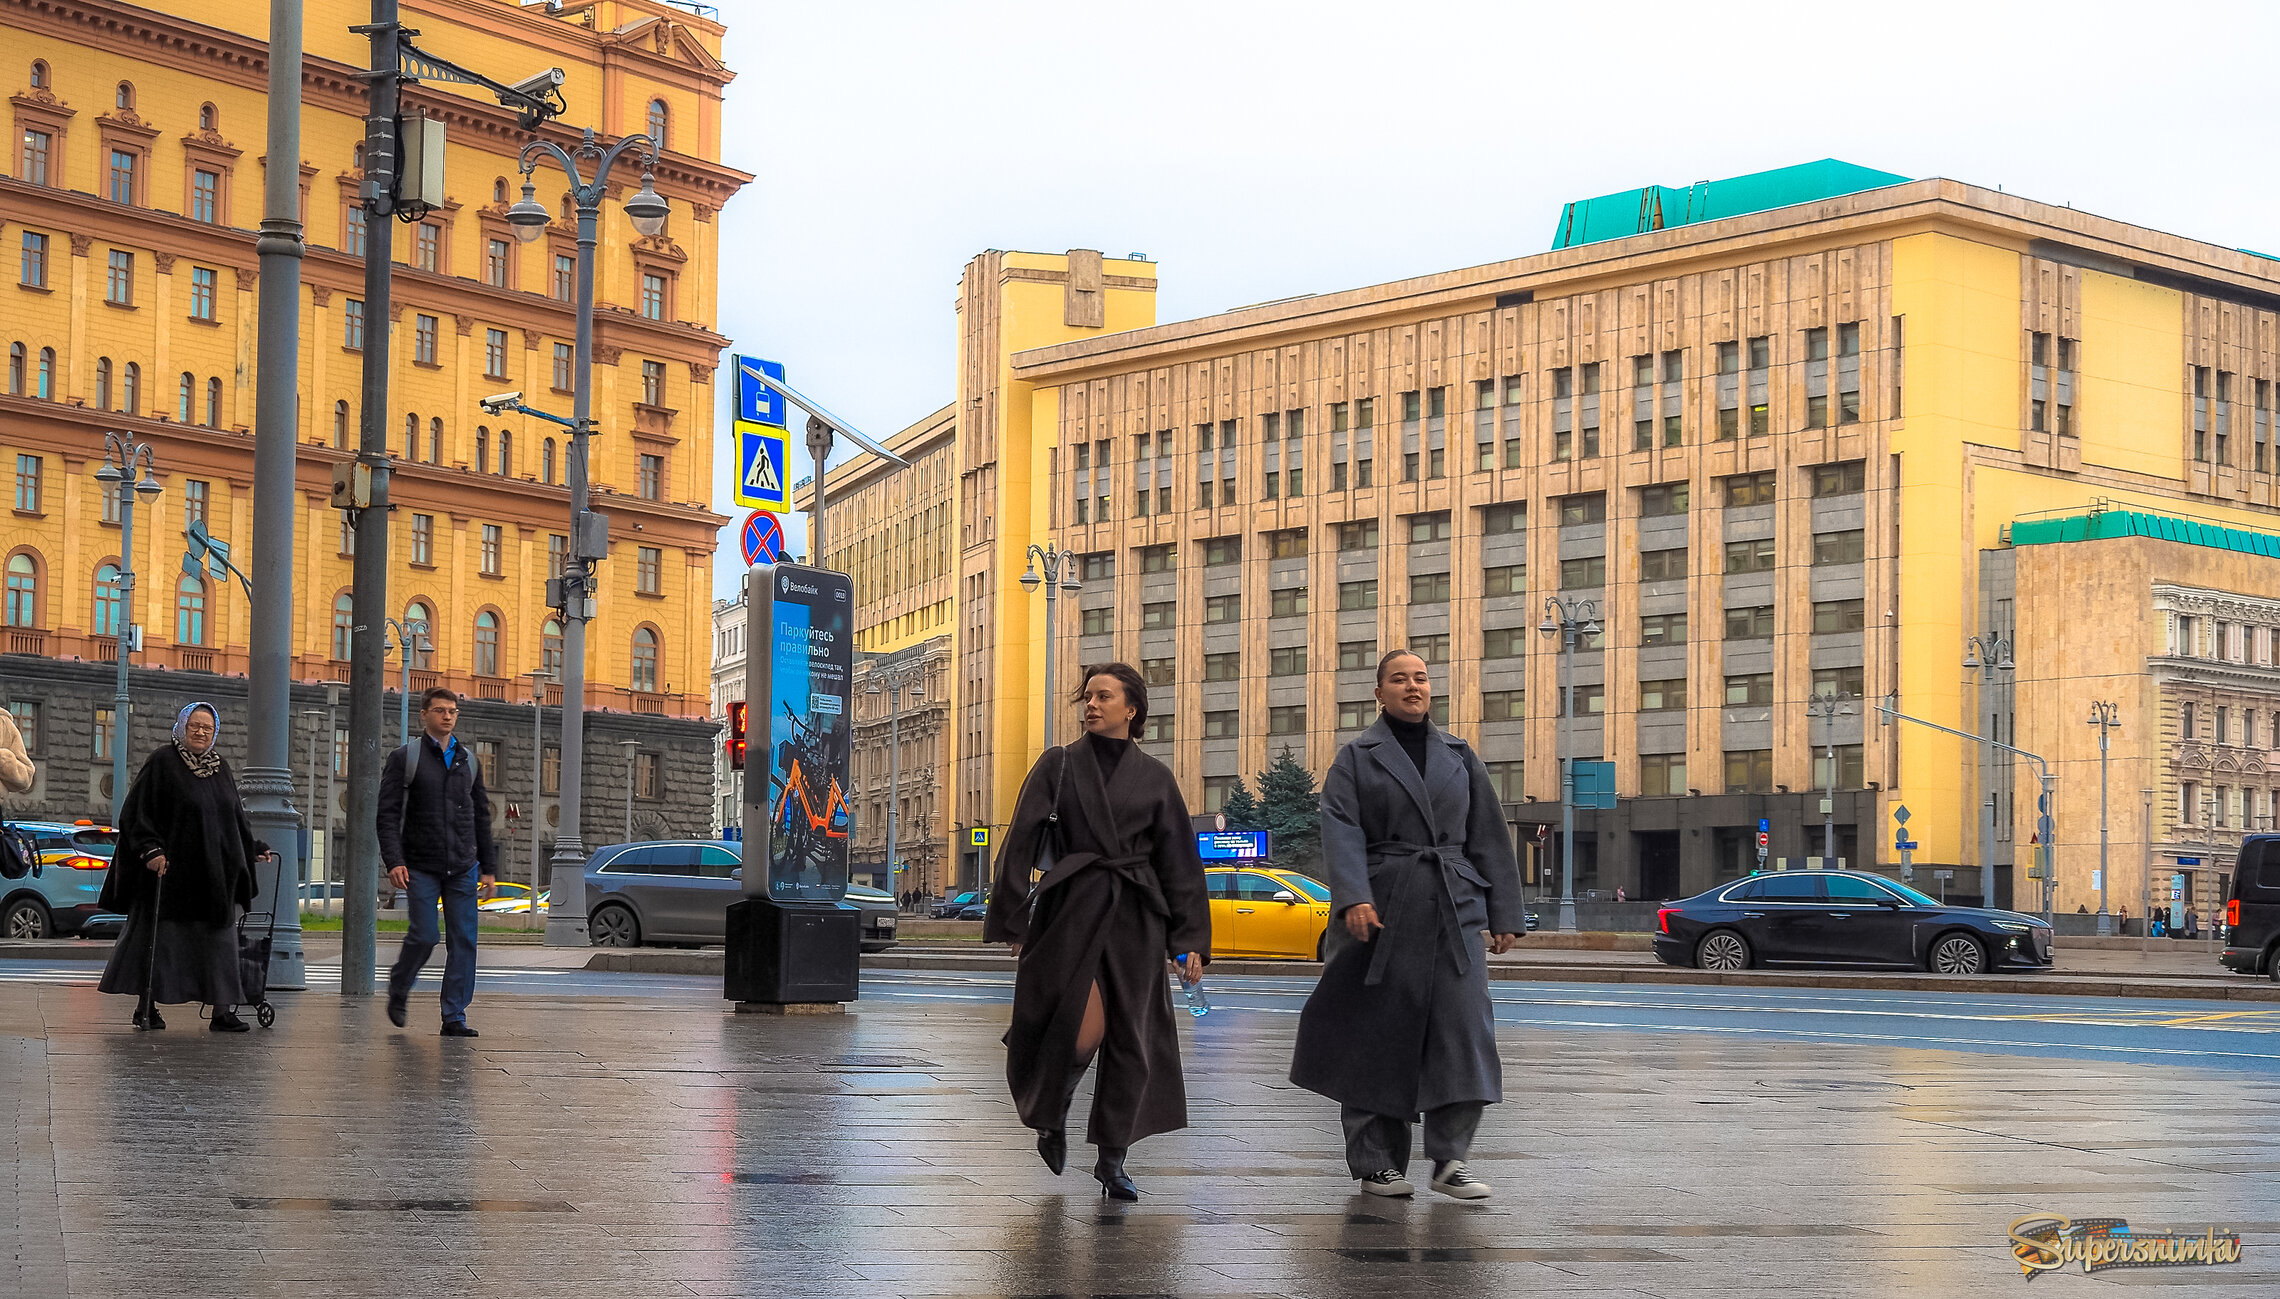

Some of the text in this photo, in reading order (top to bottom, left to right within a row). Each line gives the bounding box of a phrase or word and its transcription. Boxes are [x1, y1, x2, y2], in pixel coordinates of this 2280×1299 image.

[790, 581, 819, 596] Велобайк
[780, 621, 834, 642] Паркуйтесь
[780, 641, 830, 658] правильно
